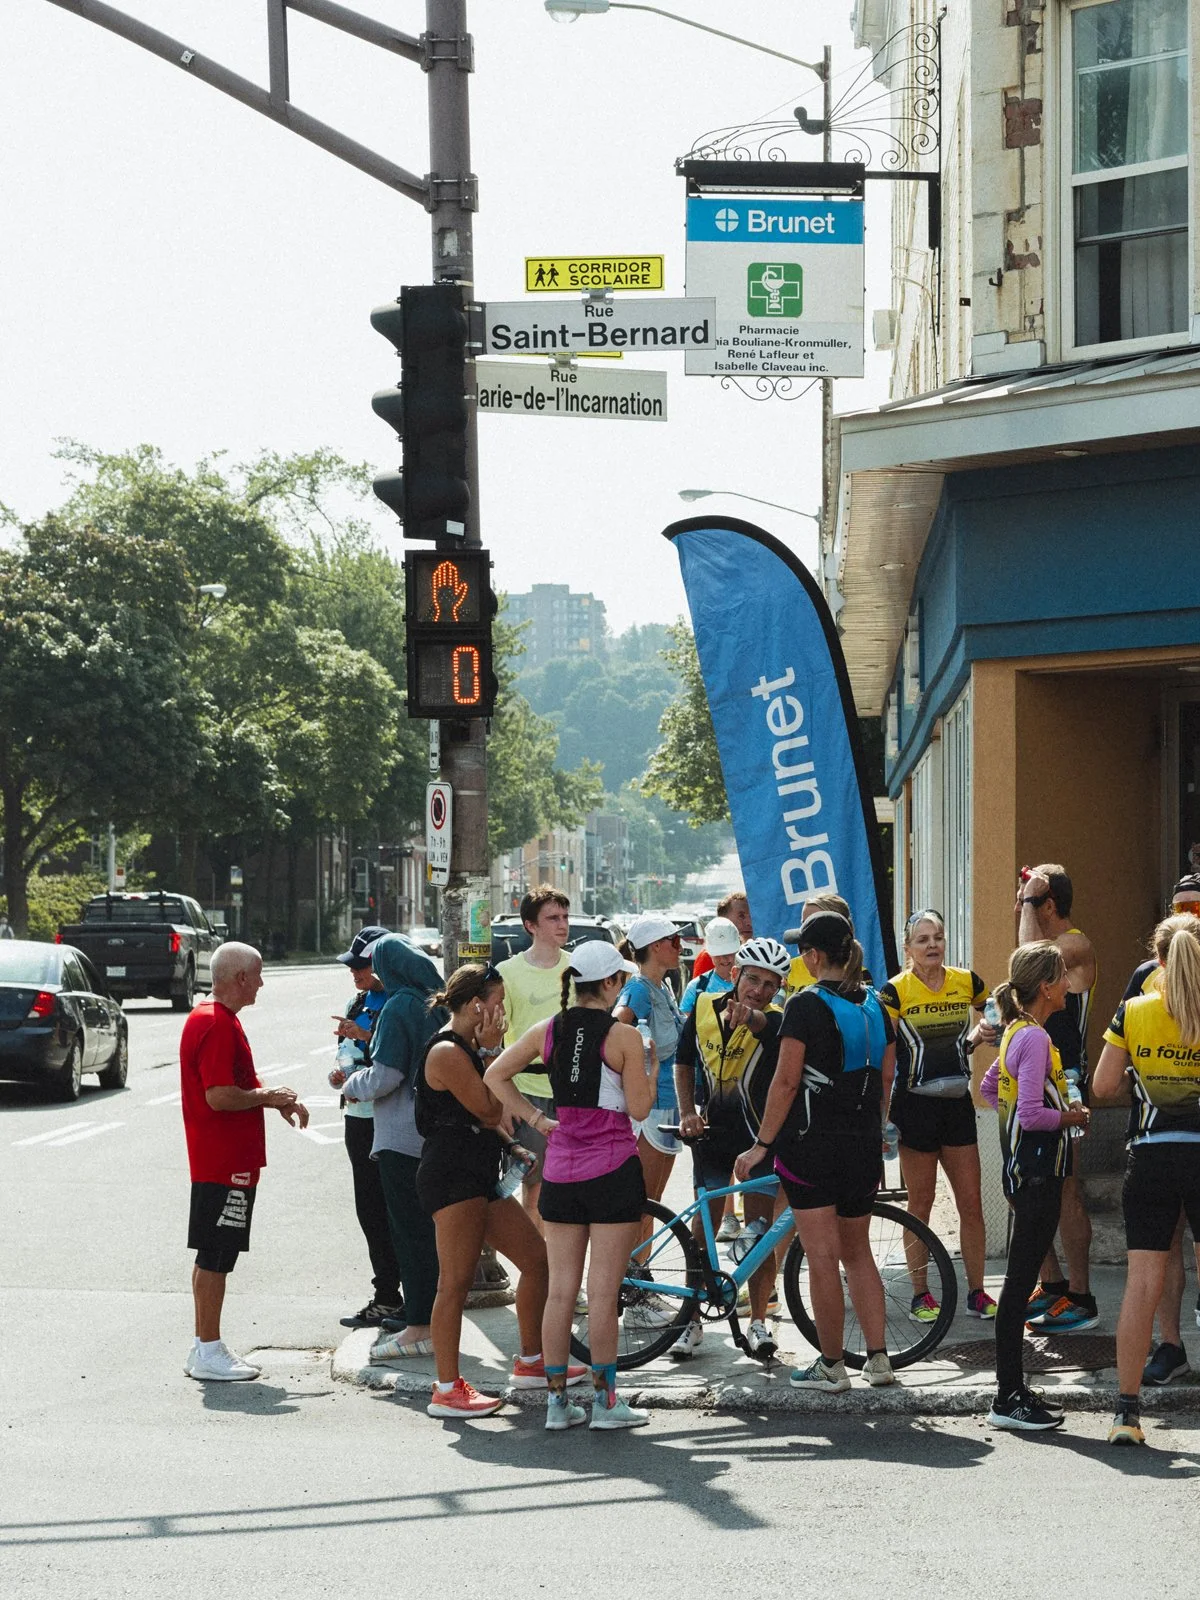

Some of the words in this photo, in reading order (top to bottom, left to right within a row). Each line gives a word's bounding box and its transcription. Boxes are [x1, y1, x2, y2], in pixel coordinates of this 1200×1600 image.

[748, 209, 835, 234] Brunet
[568, 261, 651, 274] CORRIDOR
[570, 274, 651, 286] SCOLAIRE
[584, 305, 614, 318] Rue
[491, 319, 710, 350] Saint-Bernard
[739, 325, 799, 335] Pharmacie
[728, 349, 756, 359] René
[759, 350, 800, 360] Lafleur
[803, 352, 814, 360] et
[714, 361, 758, 371] Isabelle
[761, 361, 806, 372] Claveau
[809, 363, 829, 372] inc.
[550, 369, 578, 383] Rue
[476, 383, 662, 417] arie-de-l'Incarnation
[750, 665, 839, 907] Brunet
[1136, 1044, 1151, 1058] la
